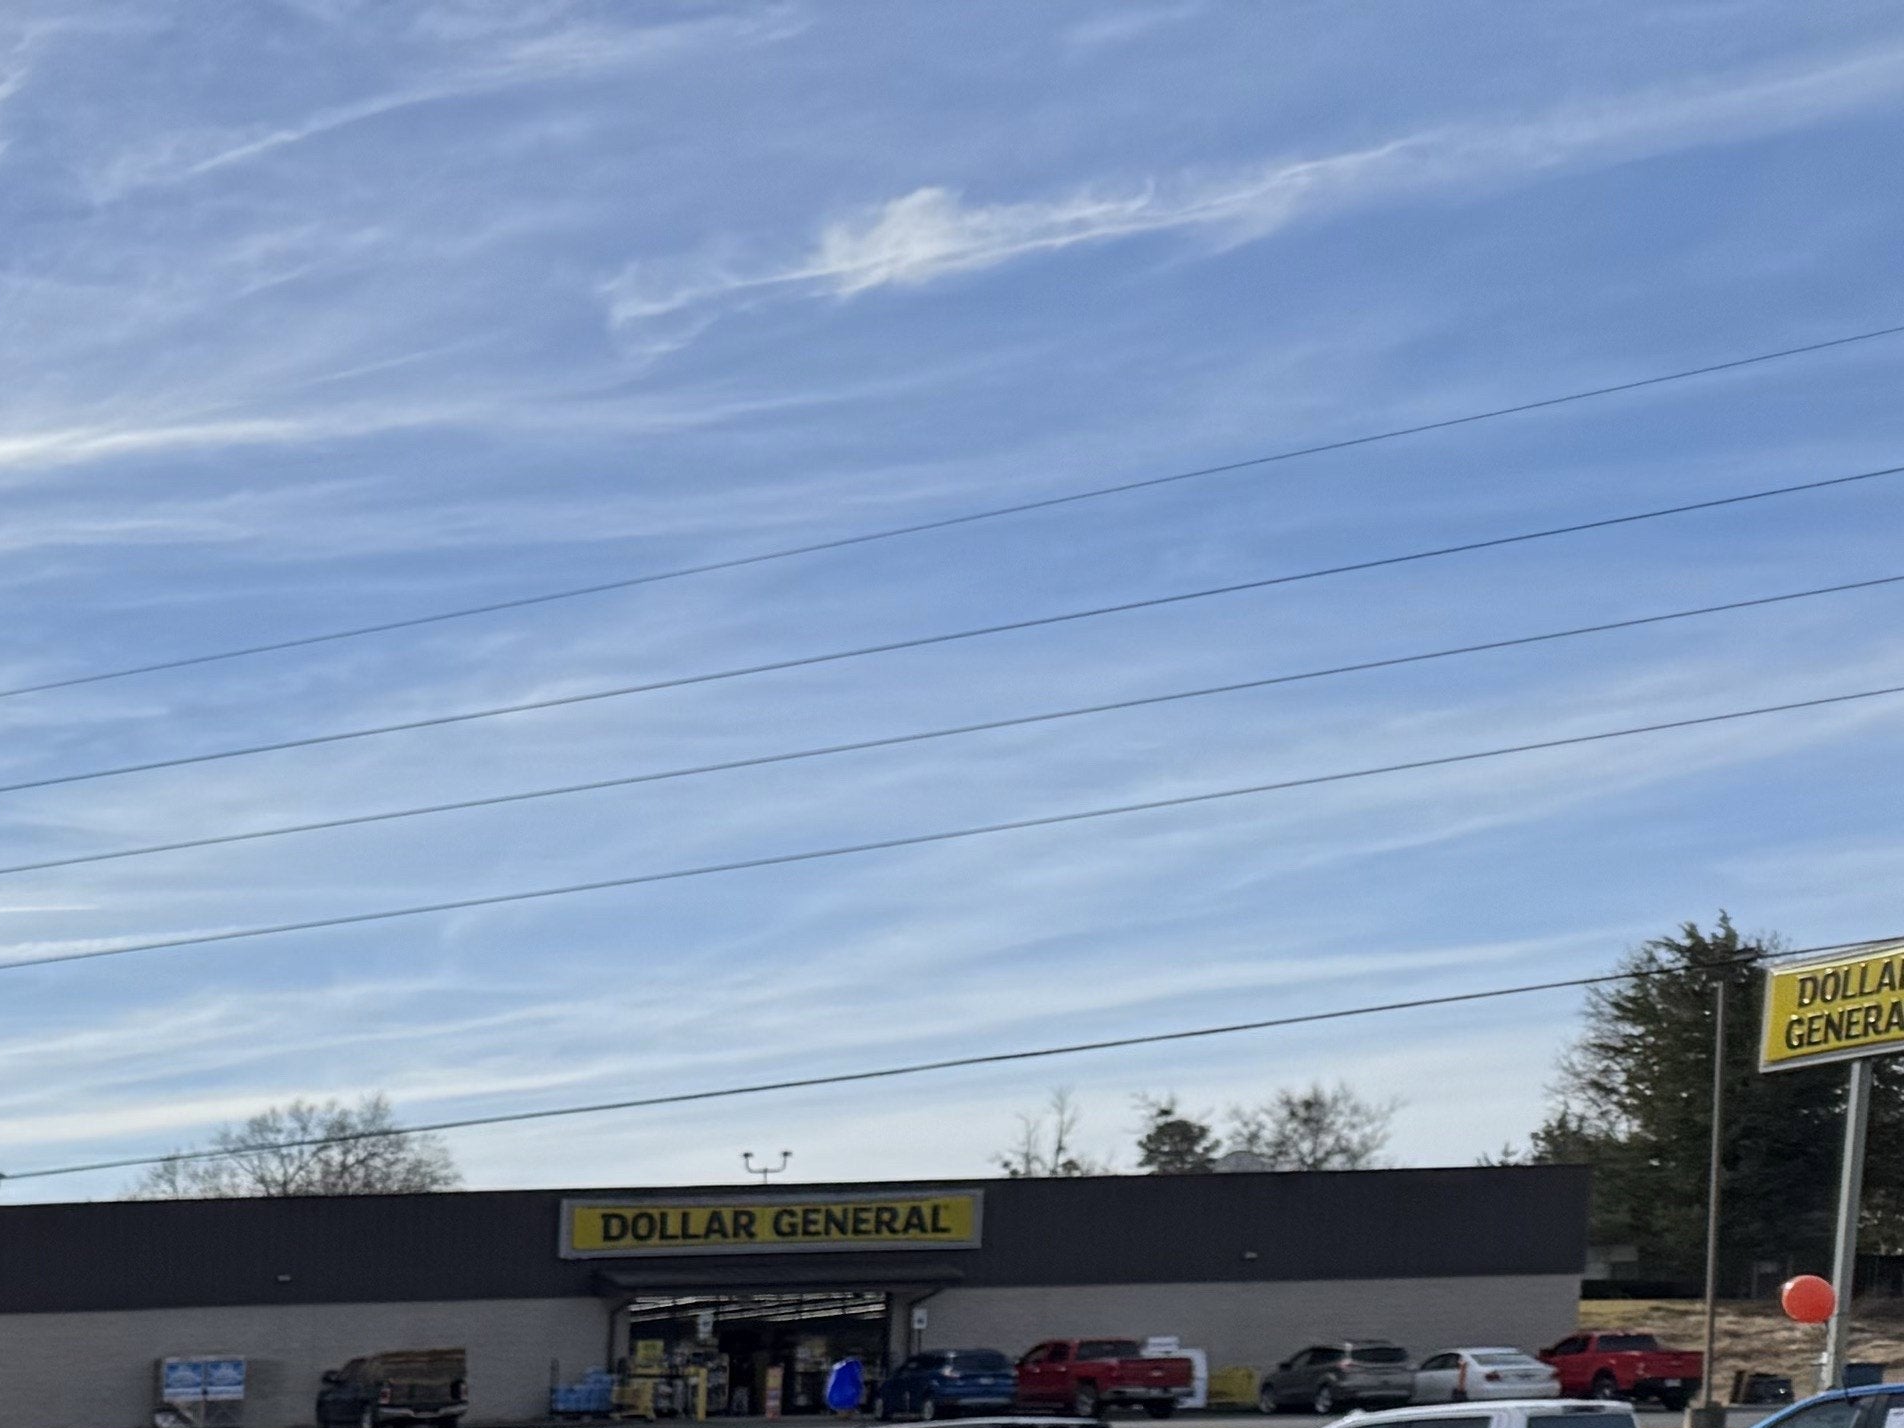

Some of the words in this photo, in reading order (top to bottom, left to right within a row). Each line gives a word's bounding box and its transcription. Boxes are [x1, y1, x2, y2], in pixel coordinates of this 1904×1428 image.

[1785, 998, 1904, 1050] GENERA
[601, 1209, 757, 1242] DOLLAR
[773, 1204, 951, 1239] GENERAL
